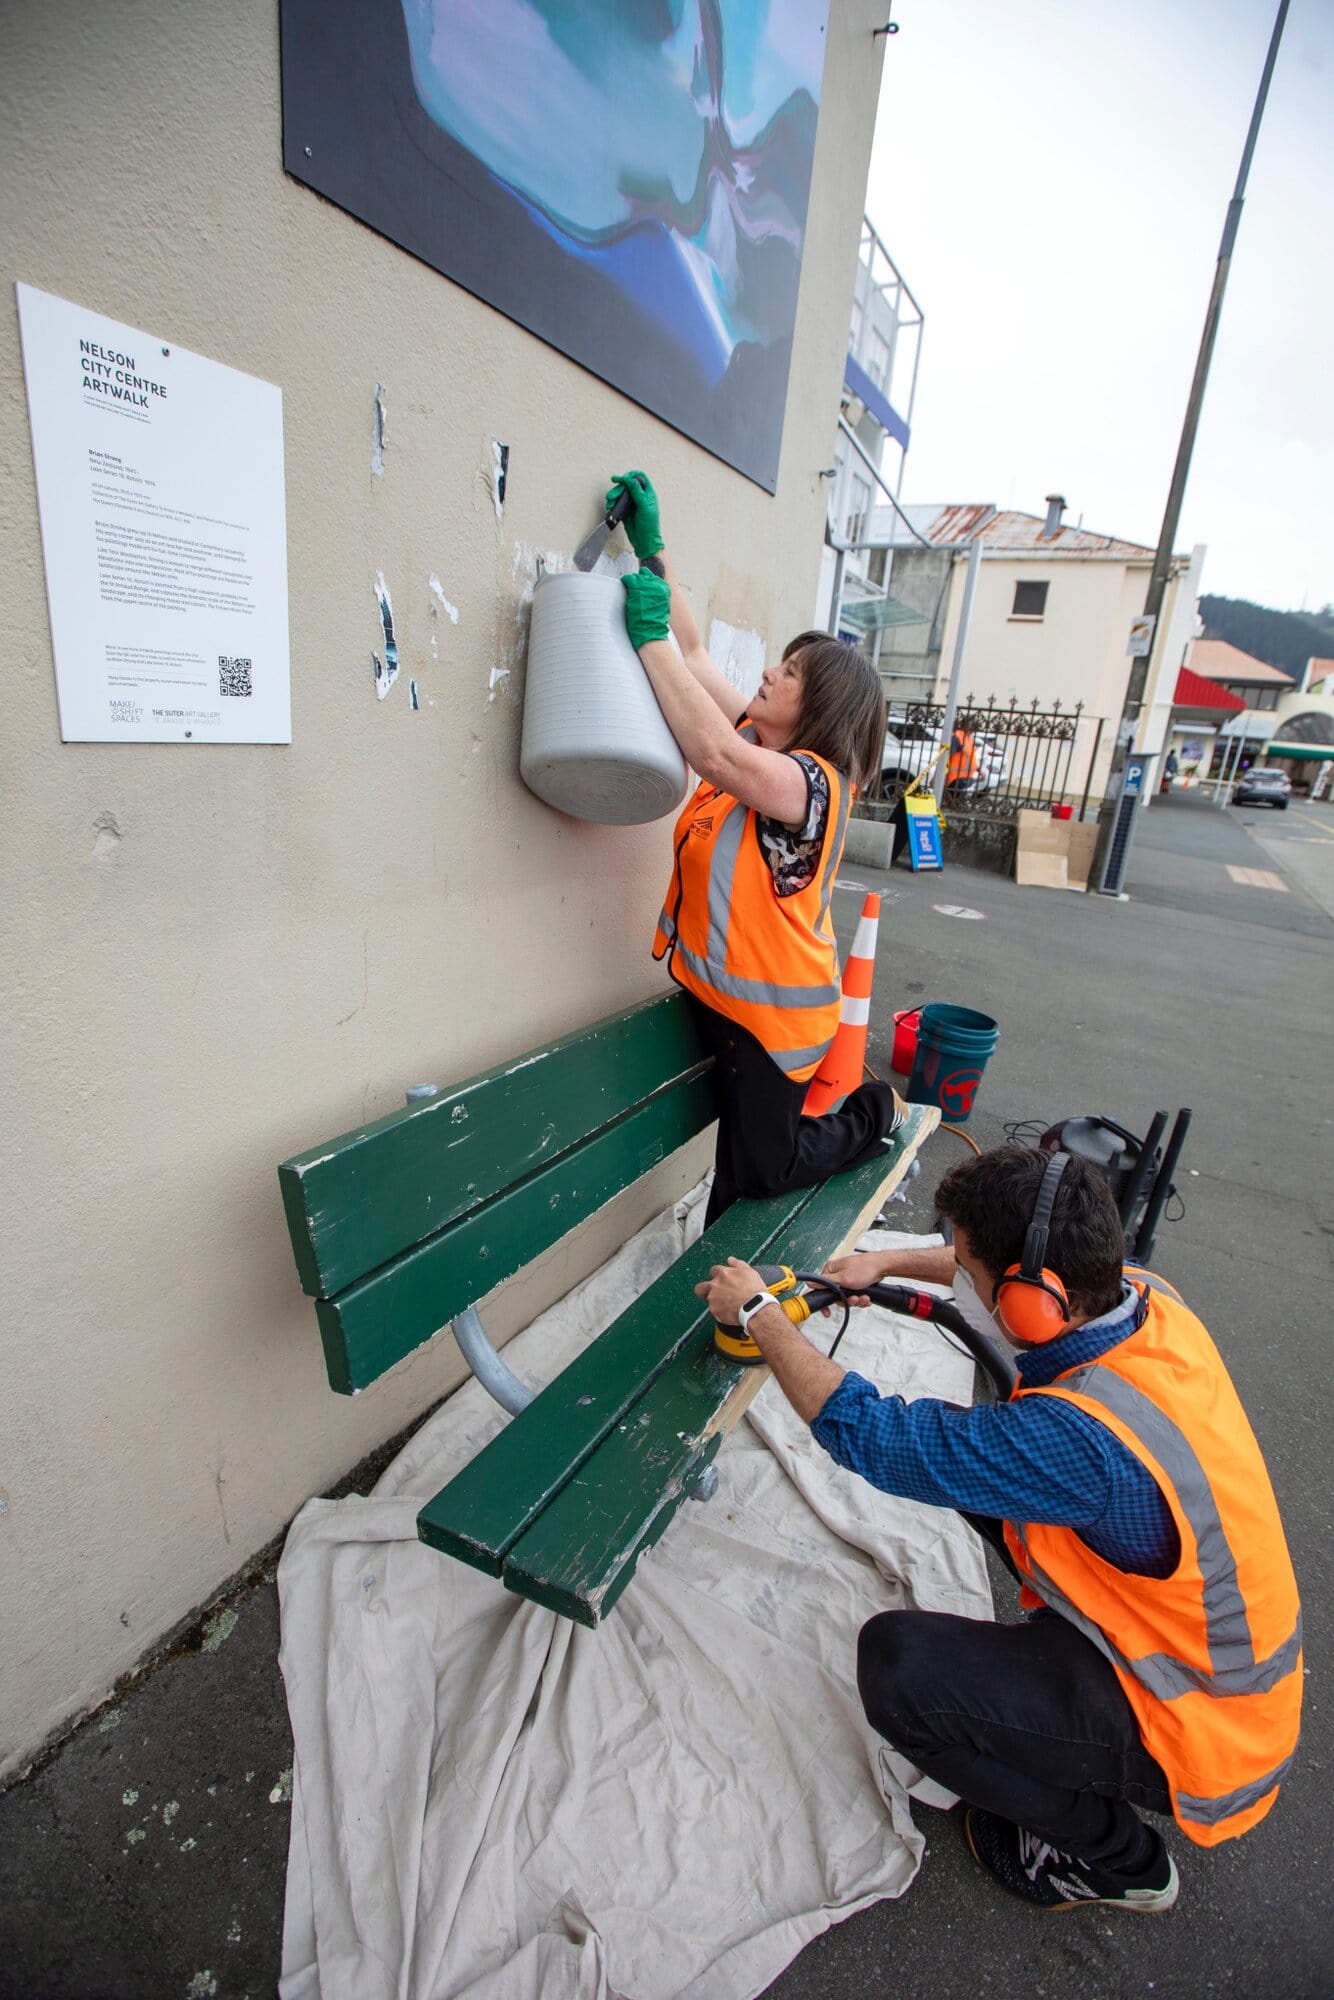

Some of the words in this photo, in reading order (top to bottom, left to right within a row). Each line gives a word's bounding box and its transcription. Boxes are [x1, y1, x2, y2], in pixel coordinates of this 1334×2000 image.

[80, 339, 135, 370] NELSON
[81, 358, 111, 378] CITY
[116, 370, 167, 398] CENTRE
[83, 376, 149, 408] ARTWALK
[89, 449, 104, 458] Brian
[104, 453, 122, 464] Strong
[90, 457, 101, 465] New
[103, 461, 124, 472] Zealand,
[90, 465, 102, 473] Lake
[103, 469, 117, 477] Series
[111, 714, 141, 723] SPACES
[1128, 767, 1141, 781] P
